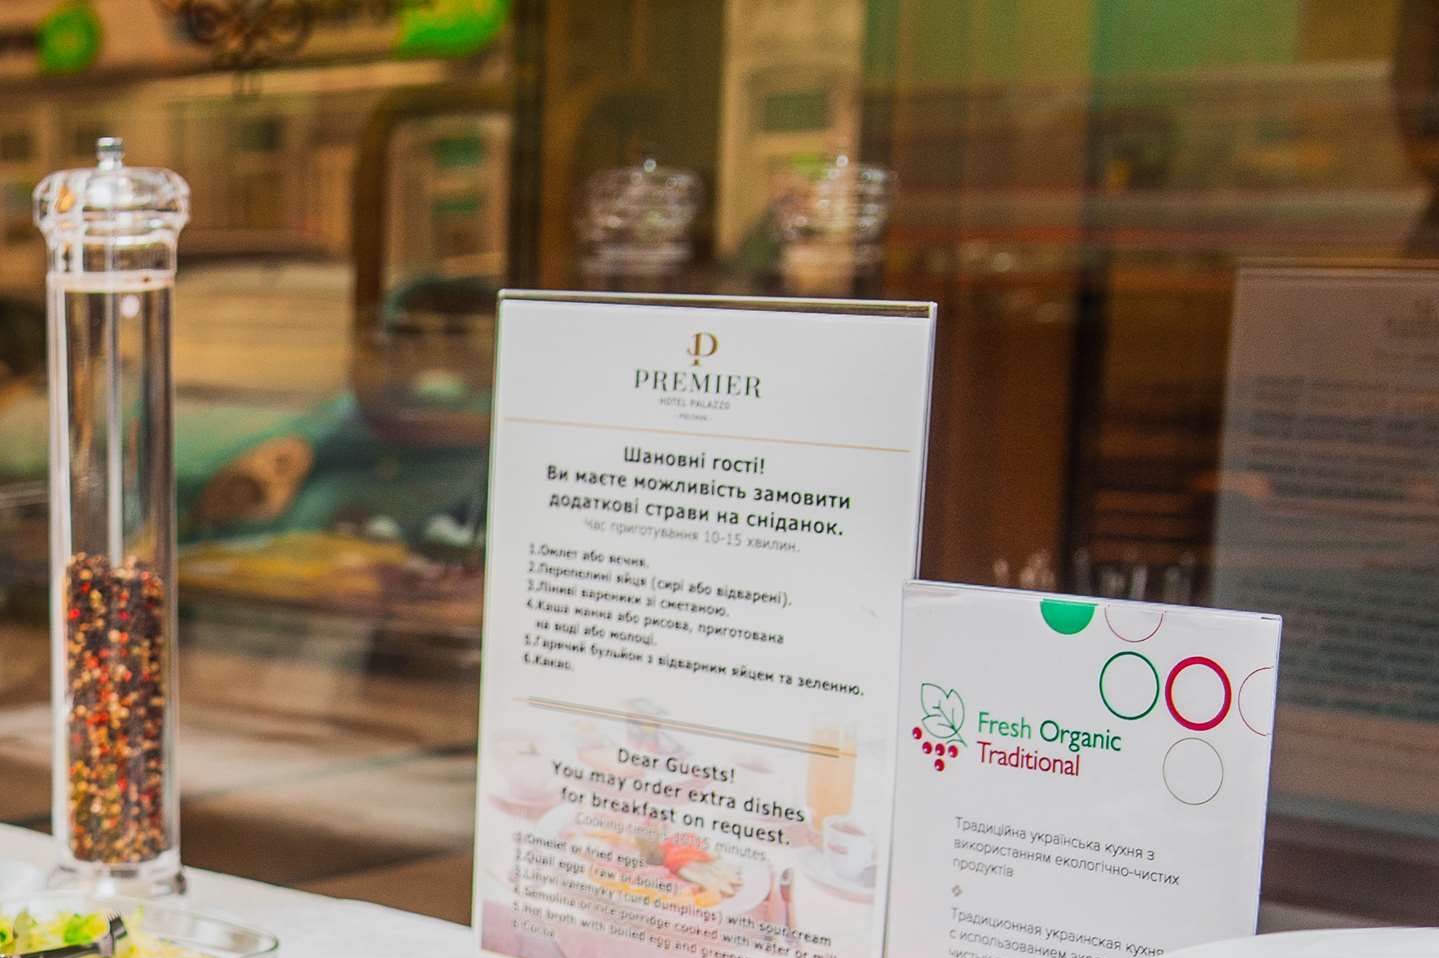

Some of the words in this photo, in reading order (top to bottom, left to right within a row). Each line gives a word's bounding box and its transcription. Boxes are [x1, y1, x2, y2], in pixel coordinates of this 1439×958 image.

[635, 368, 762, 398] PREMIER
[624, 446, 705, 469] Шановні
[713, 457, 765, 474] гості!
[546, 464, 568, 482] Ви
[576, 472, 626, 488] маєте
[634, 476, 746, 499] можливість
[753, 488, 852, 509] замовити
[550, 494, 639, 514] додаткові
[645, 504, 708, 523] страви
[717, 512, 739, 524] на
[746, 512, 844, 536] сніданок.
[584, 518, 605, 531] Час
[704, 531, 742, 547] 10-15
[746, 538, 801, 552] хвилин.
[583, 550, 605, 563] або
[582, 587, 641, 604] вареники
[660, 599, 730, 618] сметаною.
[616, 572, 648, 587] яйця
[651, 576, 684, 592] (сирі
[689, 581, 712, 596] або
[717, 585, 792, 608] відварені).
[536, 620, 548, 630] на
[554, 621, 579, 636] воді
[584, 625, 606, 639] або
[610, 631, 658, 647] молоці.
[575, 607, 612, 620] манна
[618, 610, 640, 624] або
[644, 616, 693, 634] рисова,
[698, 623, 784, 644] приготована
[590, 644, 643, 662] бульйон
[658, 655, 726, 674] відварним
[732, 664, 774, 684] яйцем
[779, 674, 792, 685] та
[798, 676, 864, 697] зеленню.
[978, 712, 1032, 739] Fresh
[1040, 720, 1122, 752] Organic
[618, 747, 660, 770] Dear
[666, 757, 736, 784] Guests!
[977, 741, 1080, 776] Traditional
[551, 760, 583, 780] You
[589, 770, 626, 791] may
[633, 777, 683, 800] order
[688, 788, 736, 810] extra
[744, 797, 806, 823] dishes
[561, 787, 586, 806] for
[591, 792, 676, 823] breakfast
[682, 811, 704, 829] on
[712, 818, 790, 846] request.
[586, 845, 614, 862] fried
[955, 816, 1026, 840] Традиційна
[1030, 831, 1100, 852] українська
[1104, 843, 1143, 860] кухня
[1147, 851, 1156, 860] з
[559, 860, 585, 873] eggs
[953, 837, 1051, 864] використанням
[1055, 855, 1180, 885] екологічно-чистих
[953, 858, 1014, 878] продуктів
[546, 909, 576, 924] broth
[581, 918, 605, 932] with
[610, 924, 645, 941] boiled
[649, 935, 671, 950] egg
[674, 942, 697, 954] and
[620, 910, 670, 929] porridge
[674, 922, 719, 939] cooked
[723, 931, 750, 946] with
[754, 940, 790, 956] water
[728, 912, 755, 929] with
[759, 921, 788, 936] sour
[792, 930, 832, 946] cream
[949, 928, 957, 940] с
[951, 907, 1042, 936] Традиционная
[1045, 927, 1122, 951] украинская
